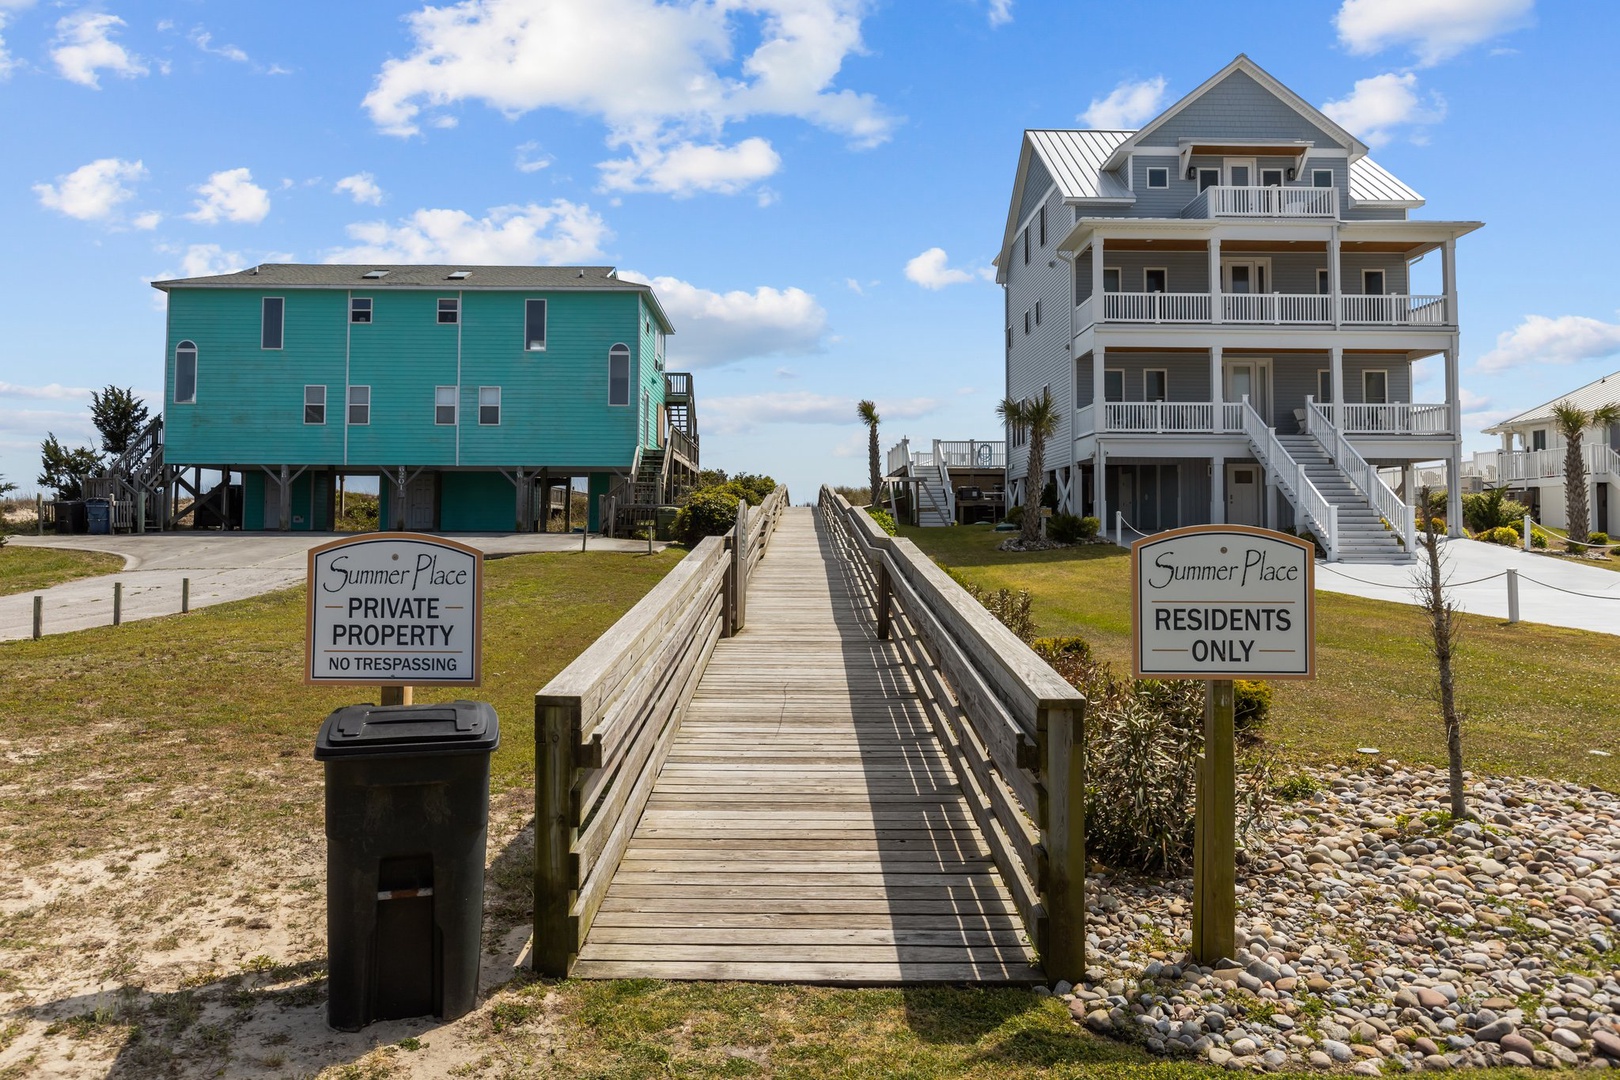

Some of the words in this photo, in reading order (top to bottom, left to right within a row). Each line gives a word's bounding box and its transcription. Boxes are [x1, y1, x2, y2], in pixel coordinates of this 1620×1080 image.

[323, 556, 410, 592] Summer
[412, 554, 467, 591] Place
[1149, 552, 1239, 588] Summer
[1241, 550, 1298, 587] Place
[348, 597, 440, 619] PRIVATE
[1155, 608, 1292, 632] RESIDENTS
[332, 624, 454, 646] PROPERTY
[1192, 639, 1255, 662] ONLY
[329, 657, 350, 670] NO
[354, 657, 457, 671] TRESPASSING
